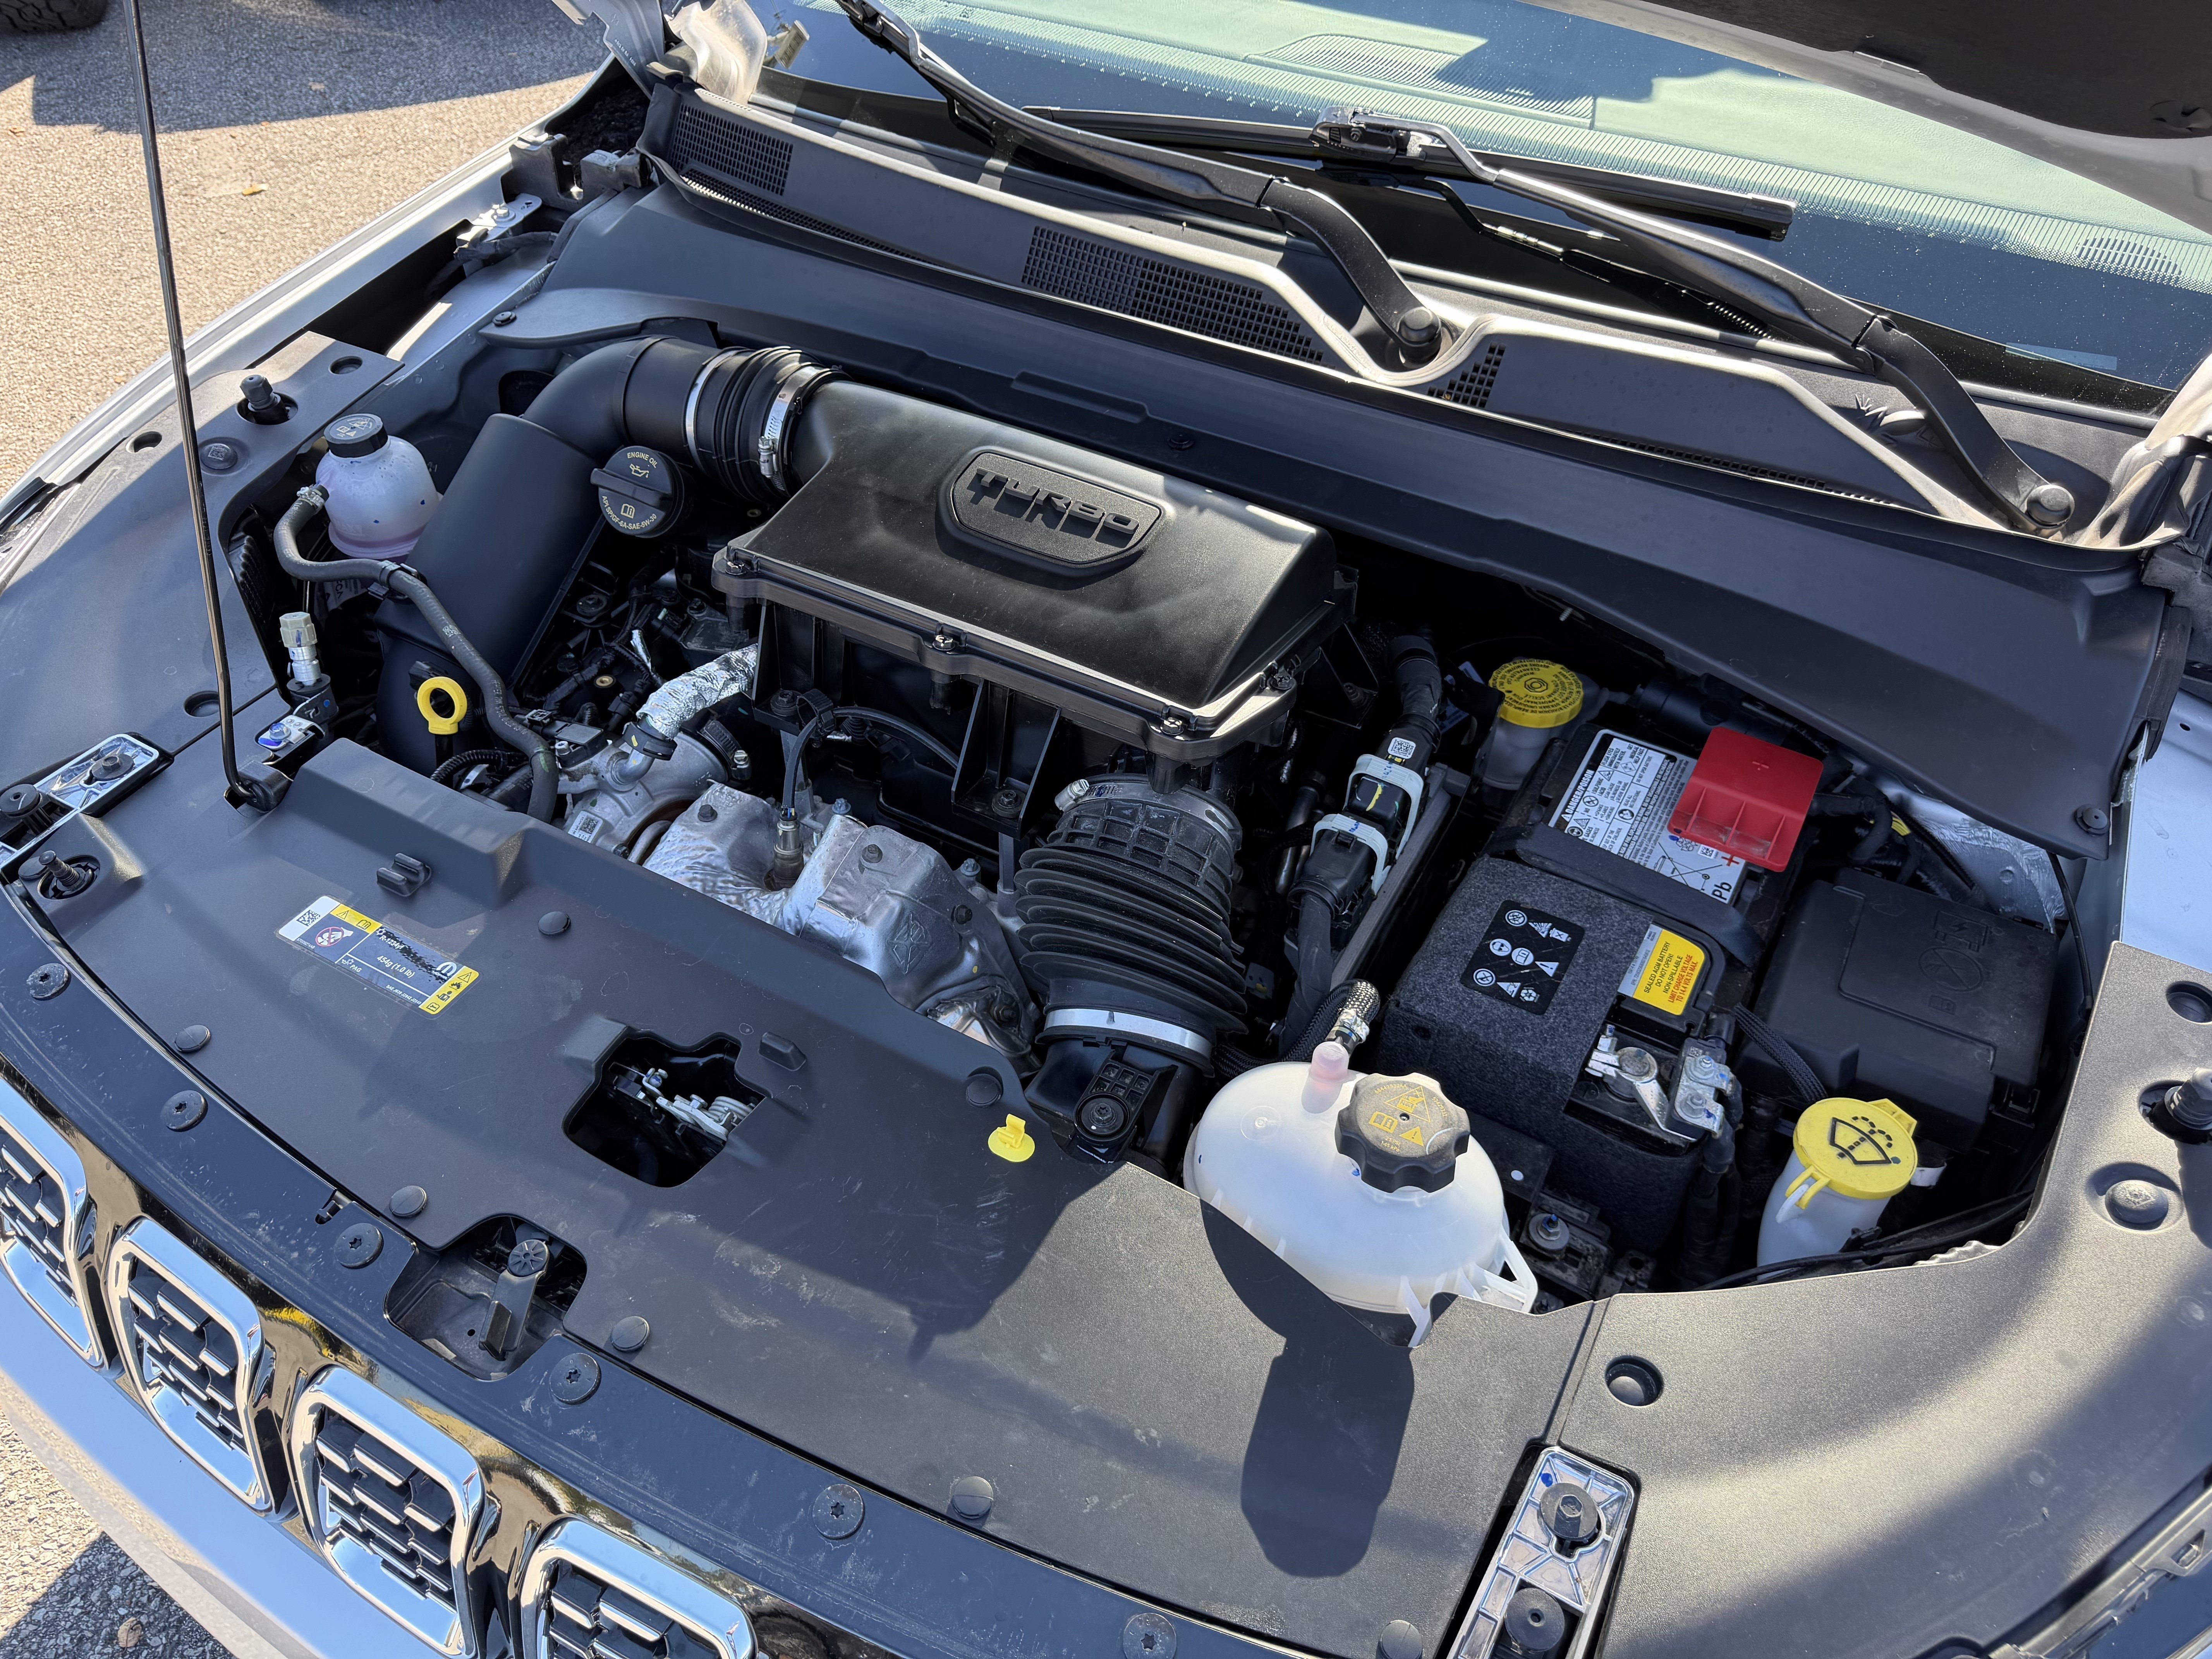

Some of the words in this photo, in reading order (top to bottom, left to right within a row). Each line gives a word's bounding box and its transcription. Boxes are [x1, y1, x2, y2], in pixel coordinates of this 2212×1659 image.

[627, 452, 649, 461] ENGINE
[649, 458, 658, 468] OIL
[976, 467, 1140, 535] TURBO
[1601, 756, 1610, 765] FLUSH
[1608, 748, 1620, 767] IMMEDIATELY
[1566, 770, 1594, 813] DANGER/POISON
[1592, 778, 1604, 792] SULFURIC
[1584, 826, 1593, 837] GASES
[1711, 882, 1732, 900] Pb
[379, 935, 405, 951] R-1234yf
[377, 956, 393, 967] 454g
[391, 963, 406, 972] (1.0
[404, 969, 415, 978] lb)
[1644, 974, 1656, 993] SEALED
[1652, 962, 1661, 974] AGM
[1657, 941, 1670, 962] BATTERY
[1655, 979, 1662, 987] DO
[1659, 967, 1667, 979] NOT
[1663, 953, 1674, 968] OPEN!
[1663, 956, 1683, 993] NON-SPILLABLE
[1679, 986, 1687, 995] 14.4
[1683, 972, 1693, 985] VOLTS
[1688, 961, 1698, 972] MAX.
[1668, 990, 1677, 1003] LIMIT
[1673, 973, 1685, 990] CHARGE
[1680, 955, 1692, 973] VOLTAGE
